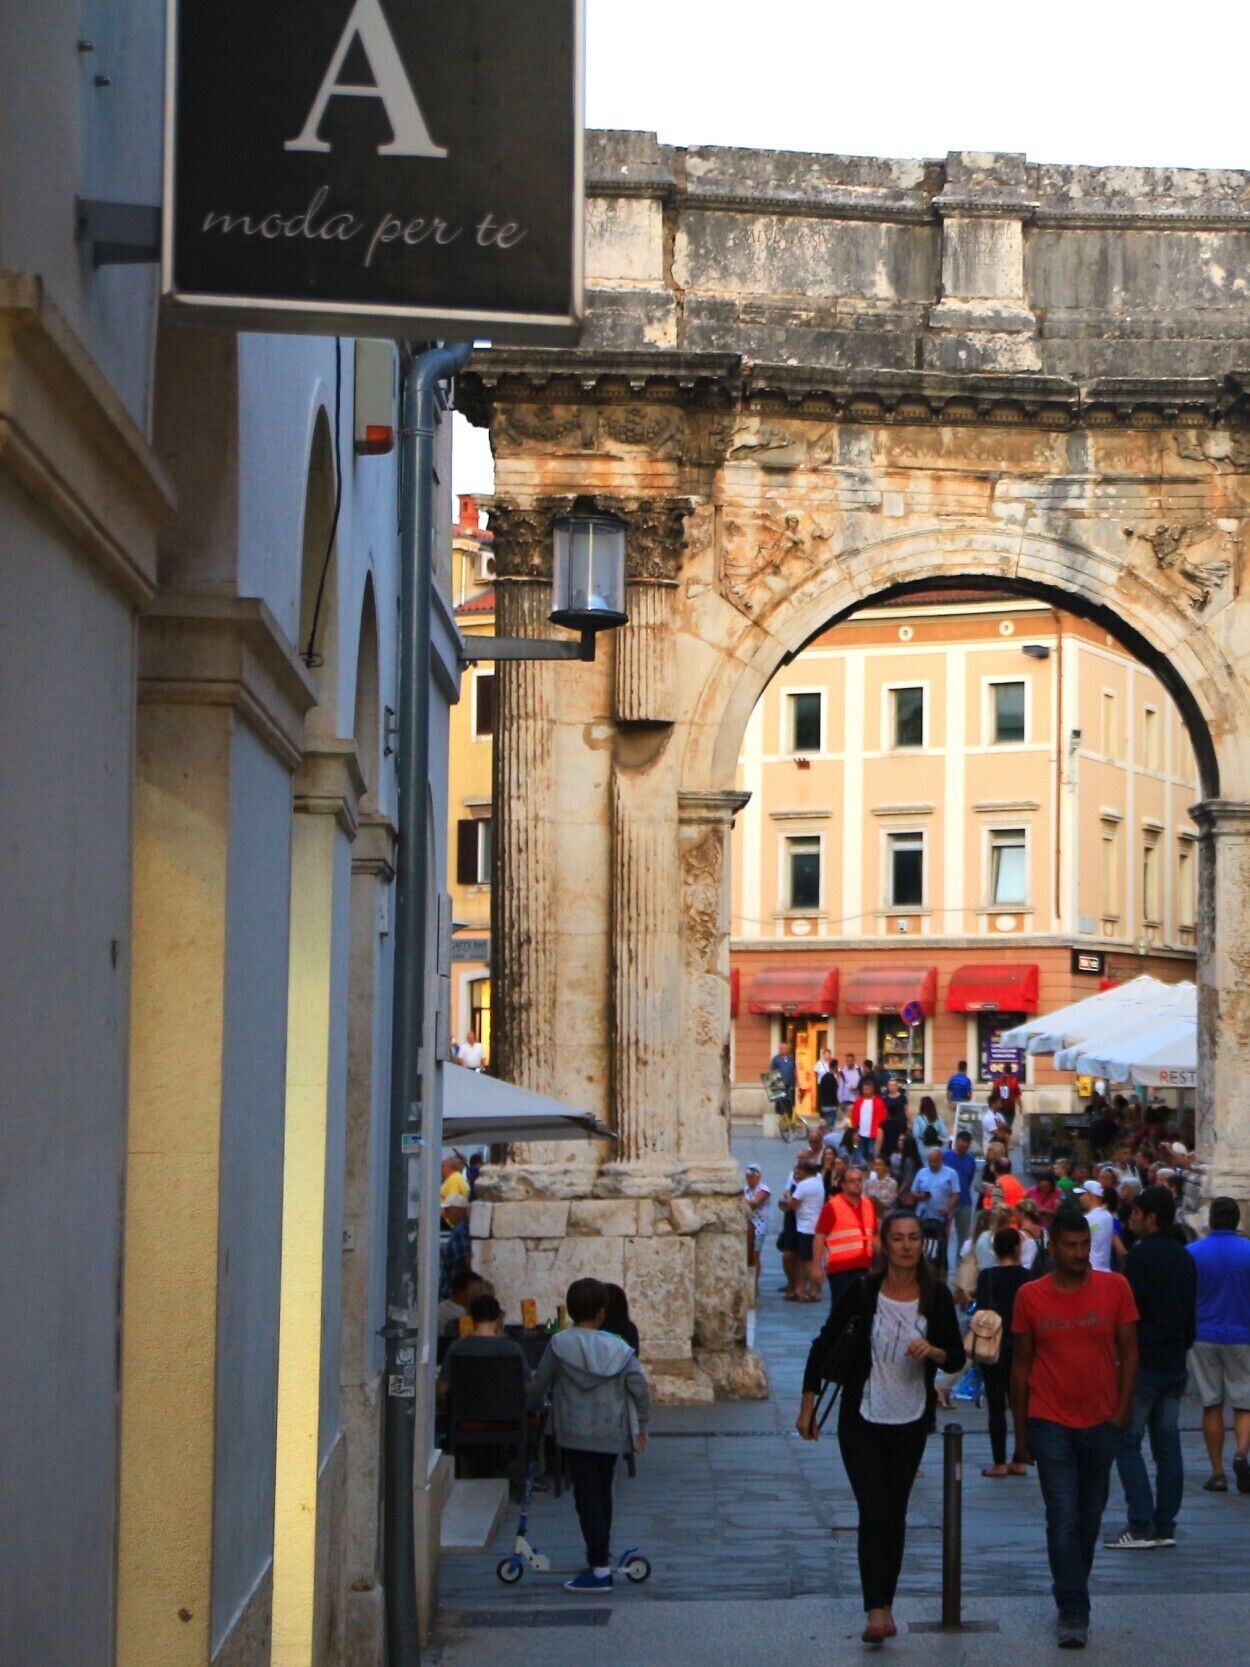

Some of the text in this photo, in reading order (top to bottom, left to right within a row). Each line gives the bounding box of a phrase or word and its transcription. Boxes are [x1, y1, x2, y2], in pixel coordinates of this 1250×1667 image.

[202, 185, 528, 268] moda per te
